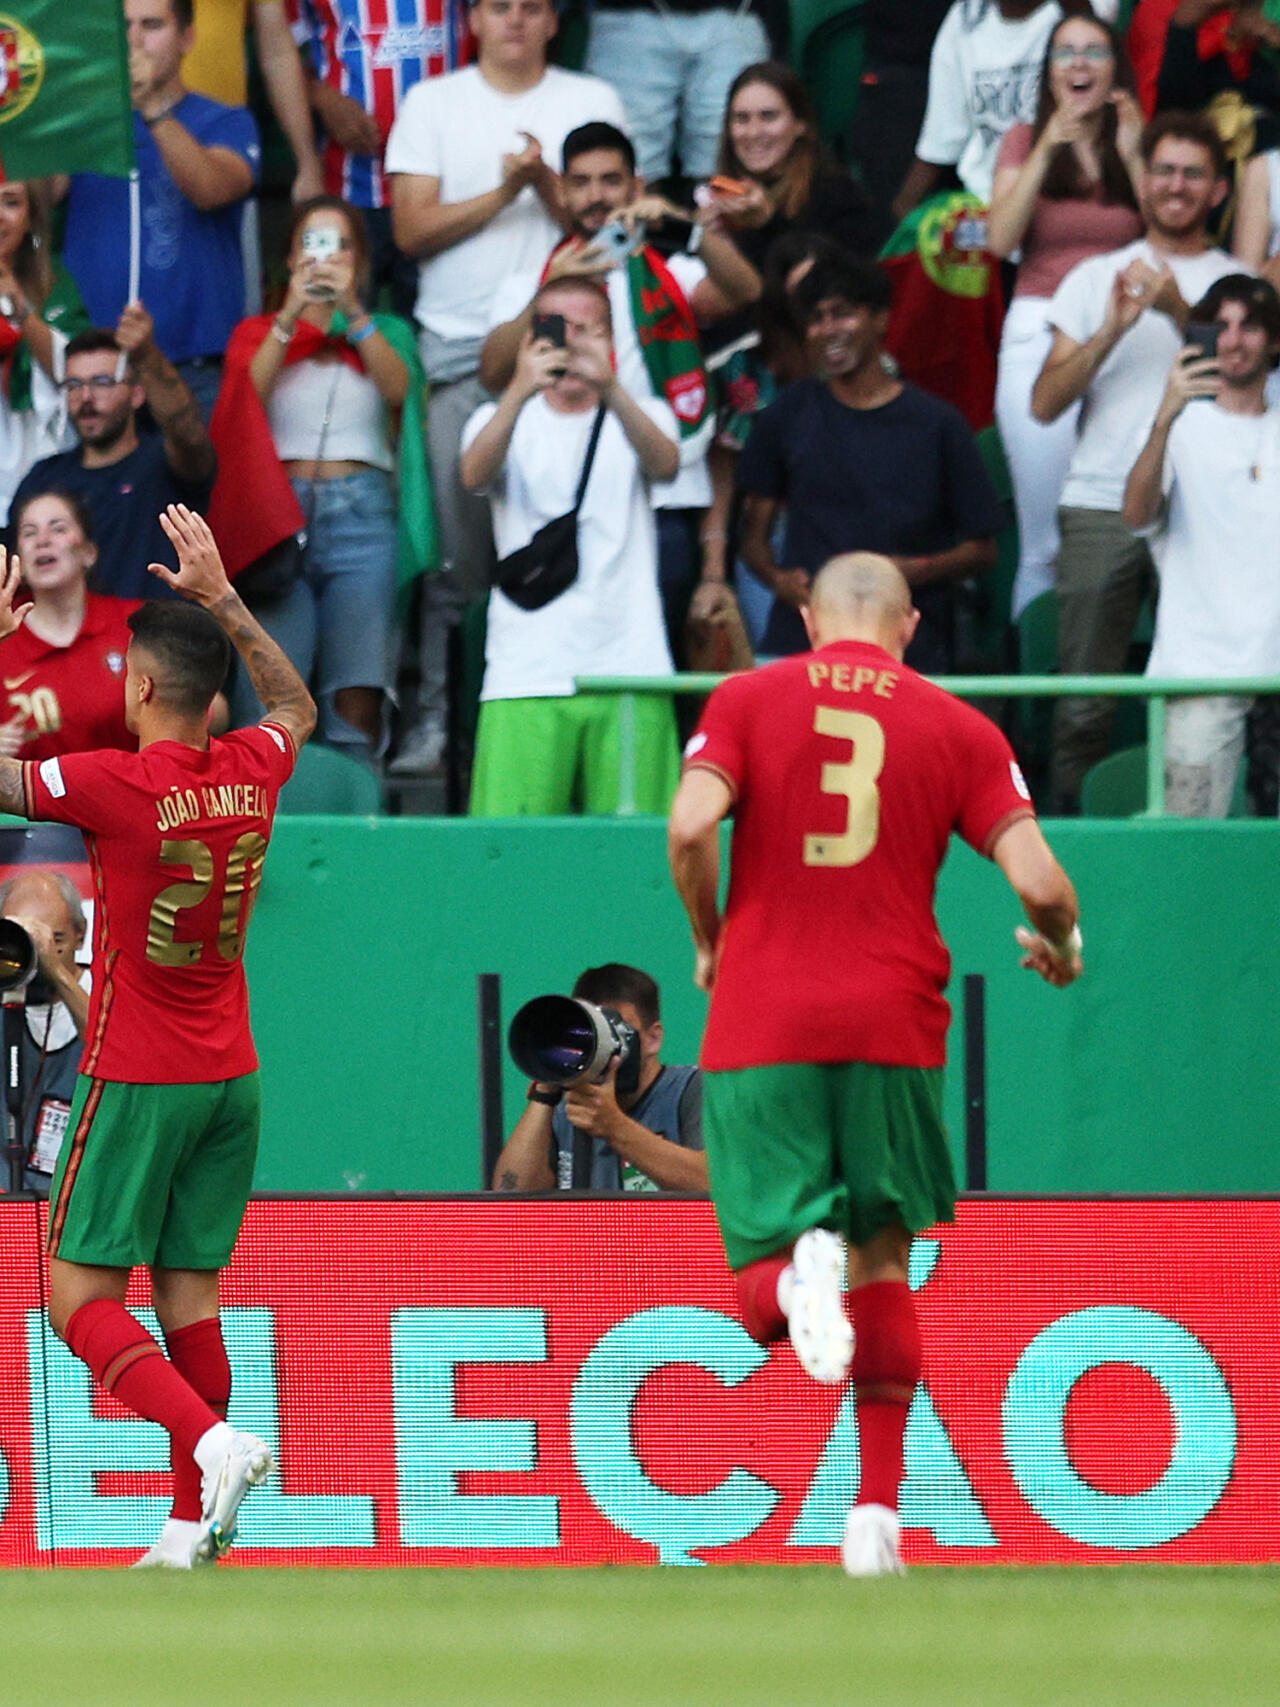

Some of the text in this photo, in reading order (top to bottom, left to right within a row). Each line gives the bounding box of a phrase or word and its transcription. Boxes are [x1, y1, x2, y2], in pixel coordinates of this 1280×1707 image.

[807, 663, 900, 699] PEPE
[155, 785, 268, 832] JOÃO CANCELO
[803, 705, 886, 867] 3
[146, 832, 270, 967] 20
